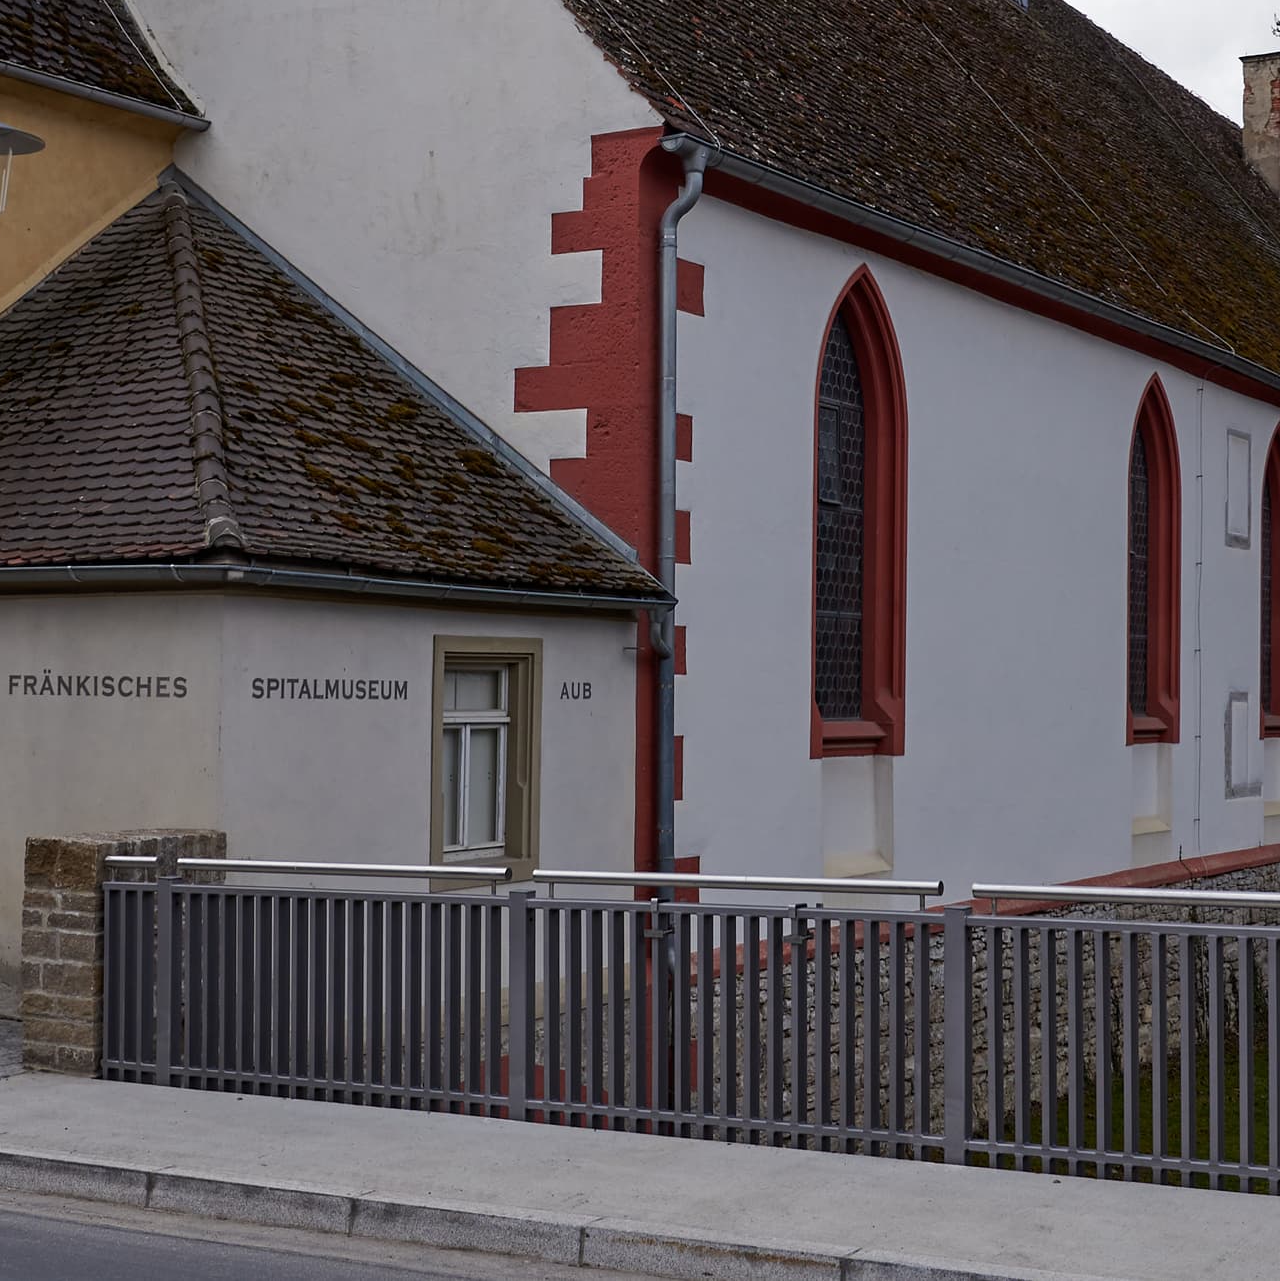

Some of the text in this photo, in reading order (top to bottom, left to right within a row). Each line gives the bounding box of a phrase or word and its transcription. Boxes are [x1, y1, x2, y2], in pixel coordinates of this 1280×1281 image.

[9, 669, 592, 700] FRÄNKISCHES SPITALMUSEUM AUB
